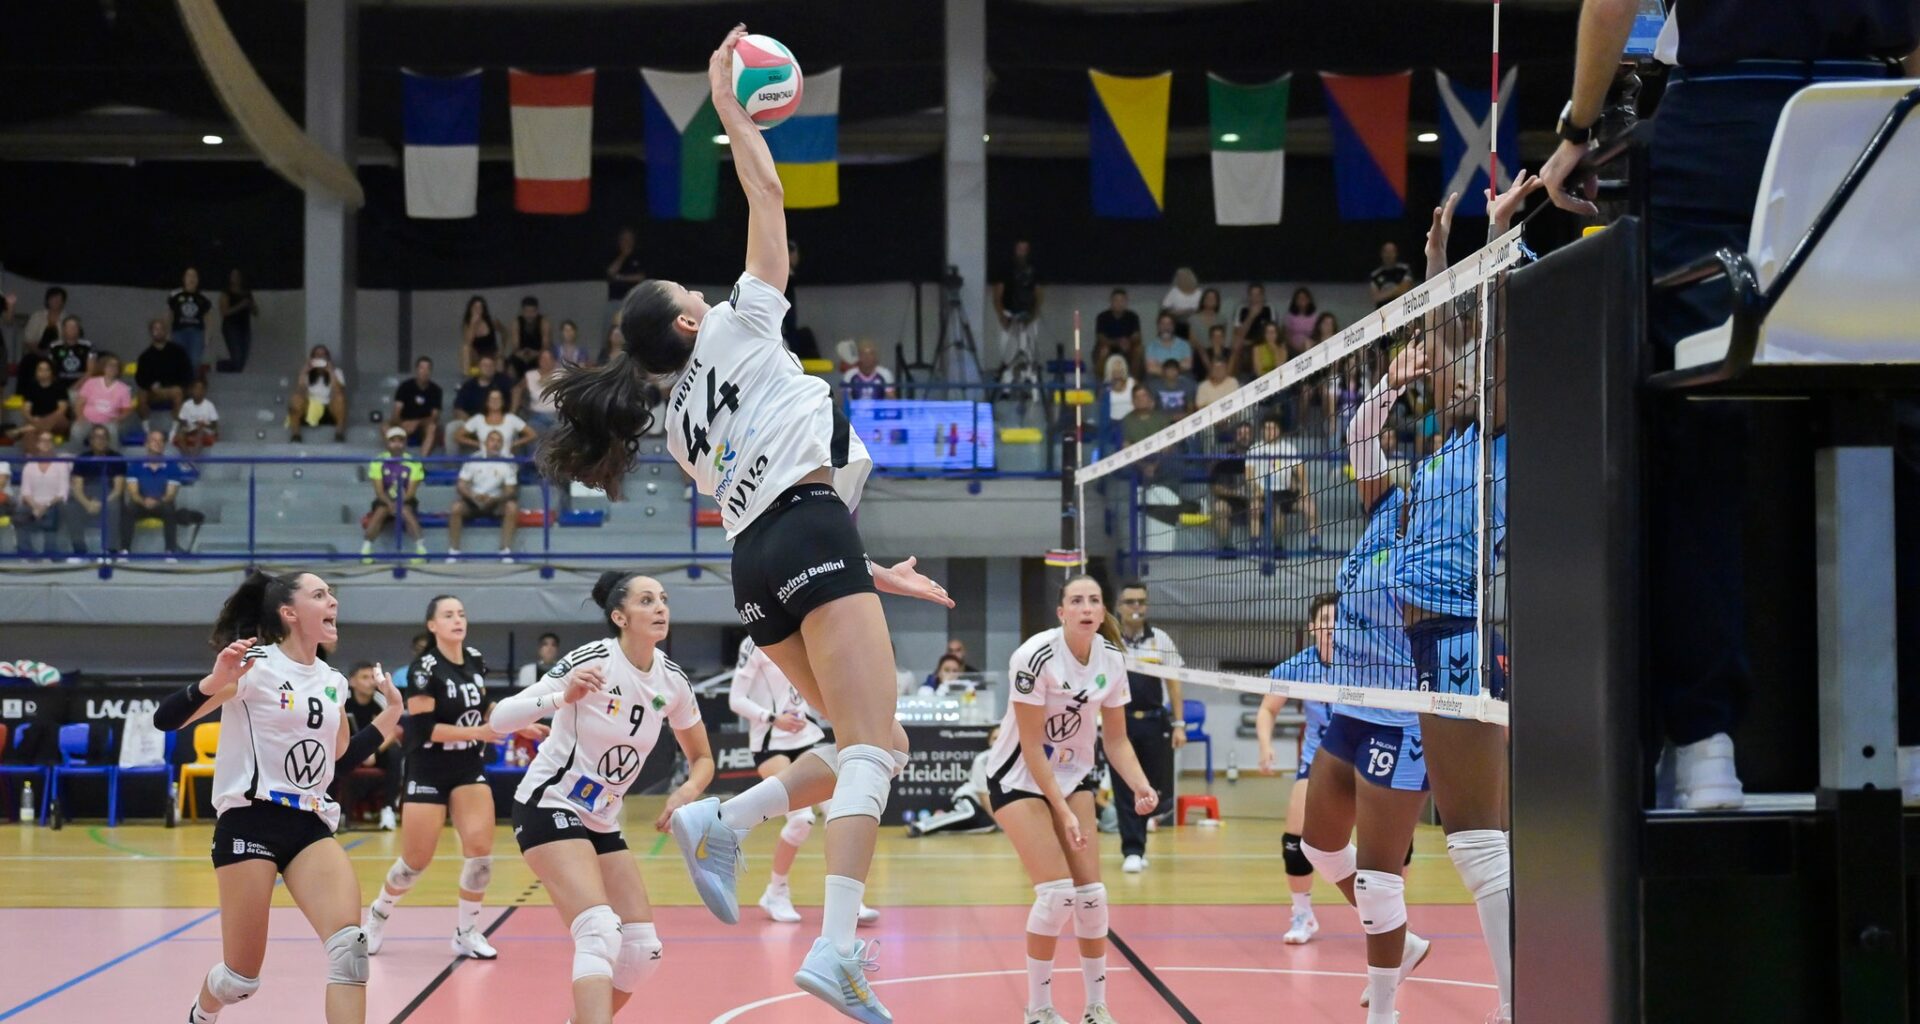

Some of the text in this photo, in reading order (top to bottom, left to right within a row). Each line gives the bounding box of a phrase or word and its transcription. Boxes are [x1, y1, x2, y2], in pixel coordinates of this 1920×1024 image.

[683, 366, 741, 466] 44
[459, 683, 481, 707] 13
[307, 697, 323, 729] 8
[629, 704, 644, 736] 9
[1367, 748, 1394, 776] 19
